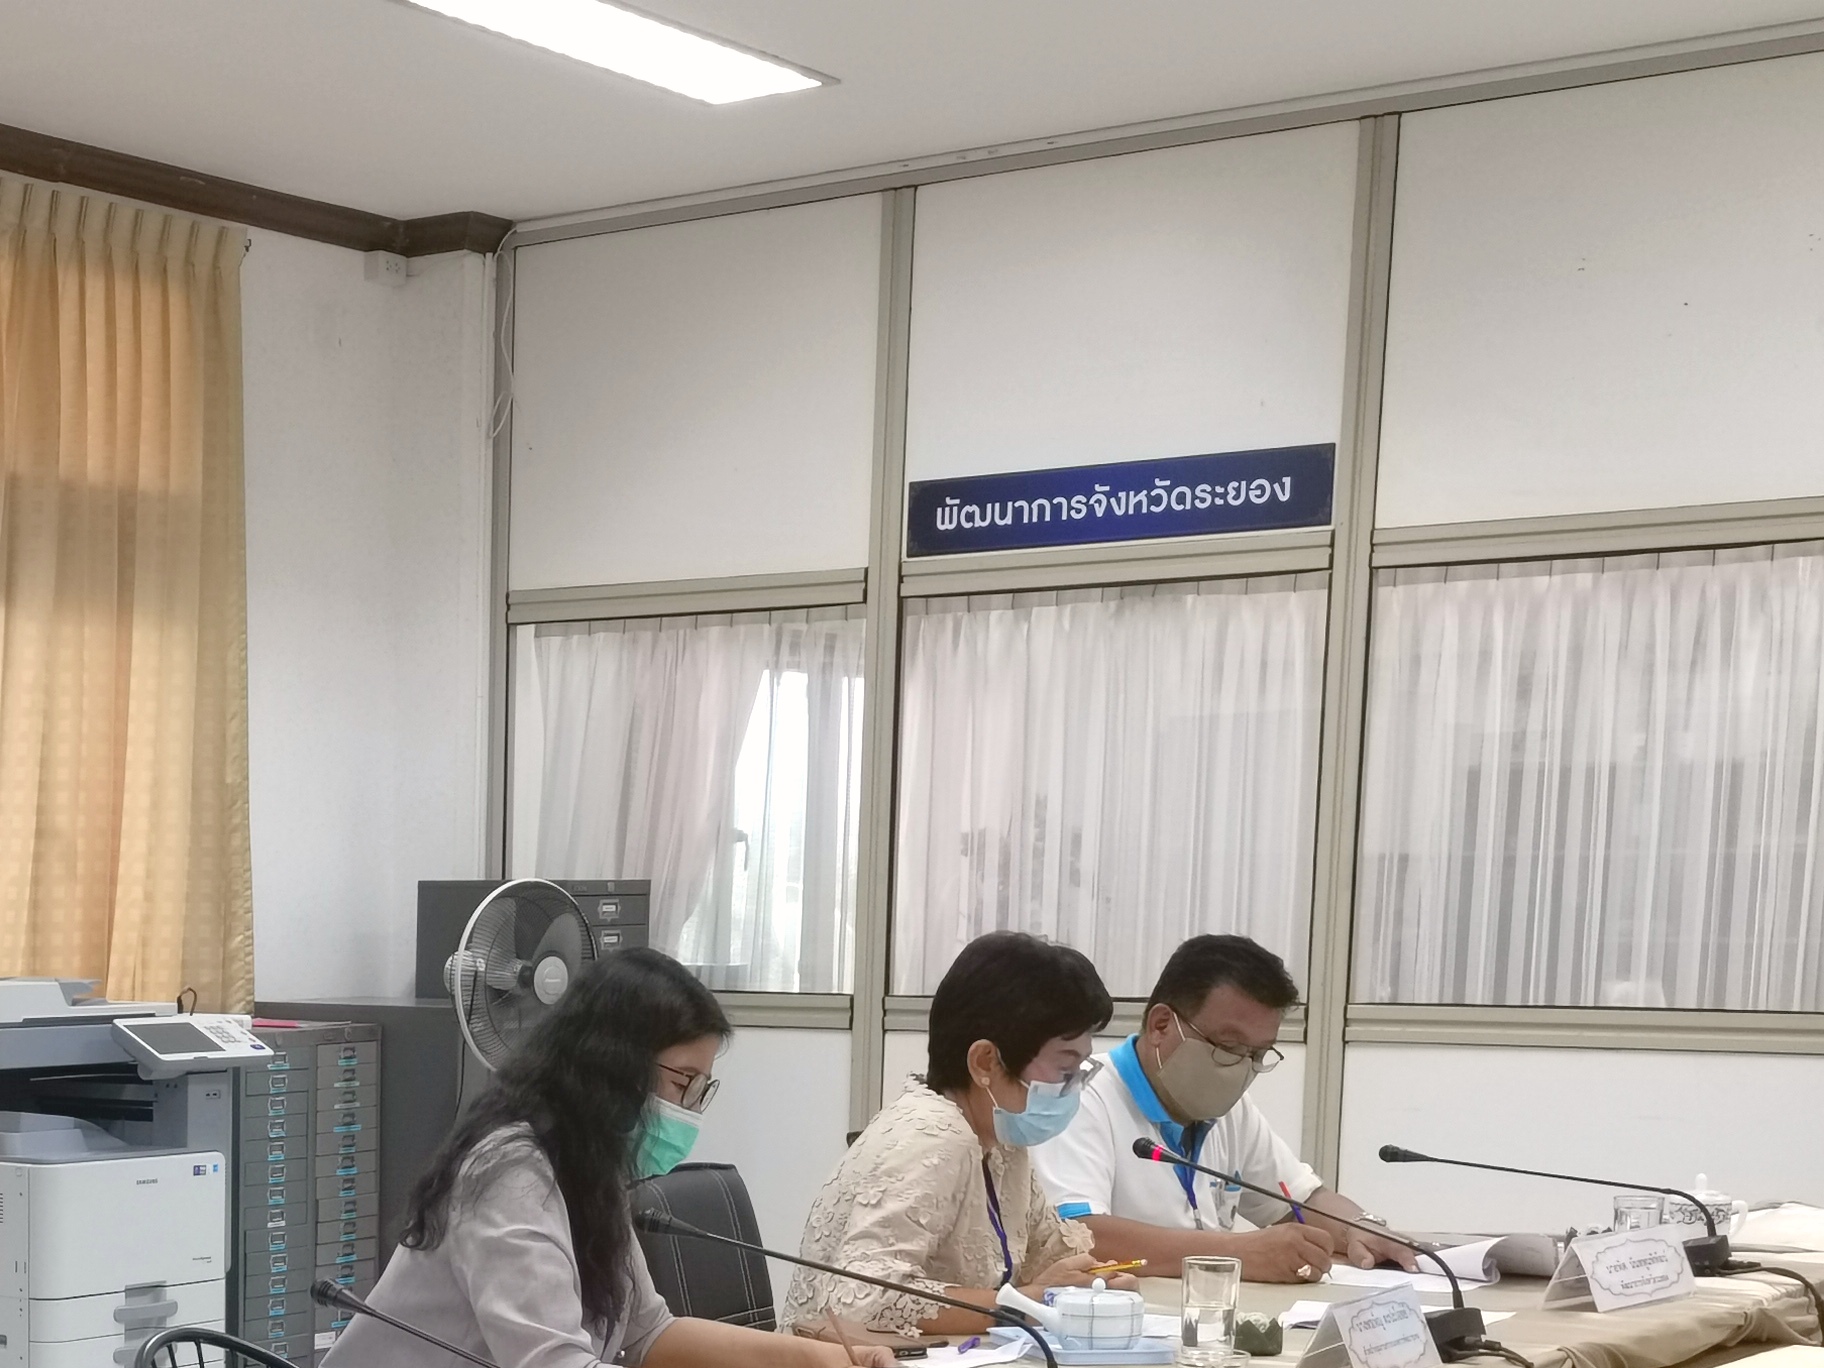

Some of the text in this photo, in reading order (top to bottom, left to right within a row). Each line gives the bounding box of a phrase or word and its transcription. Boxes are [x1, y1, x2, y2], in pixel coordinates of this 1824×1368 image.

[935, 475, 1292, 532] พัฒนาการจังหวัดระยอง
